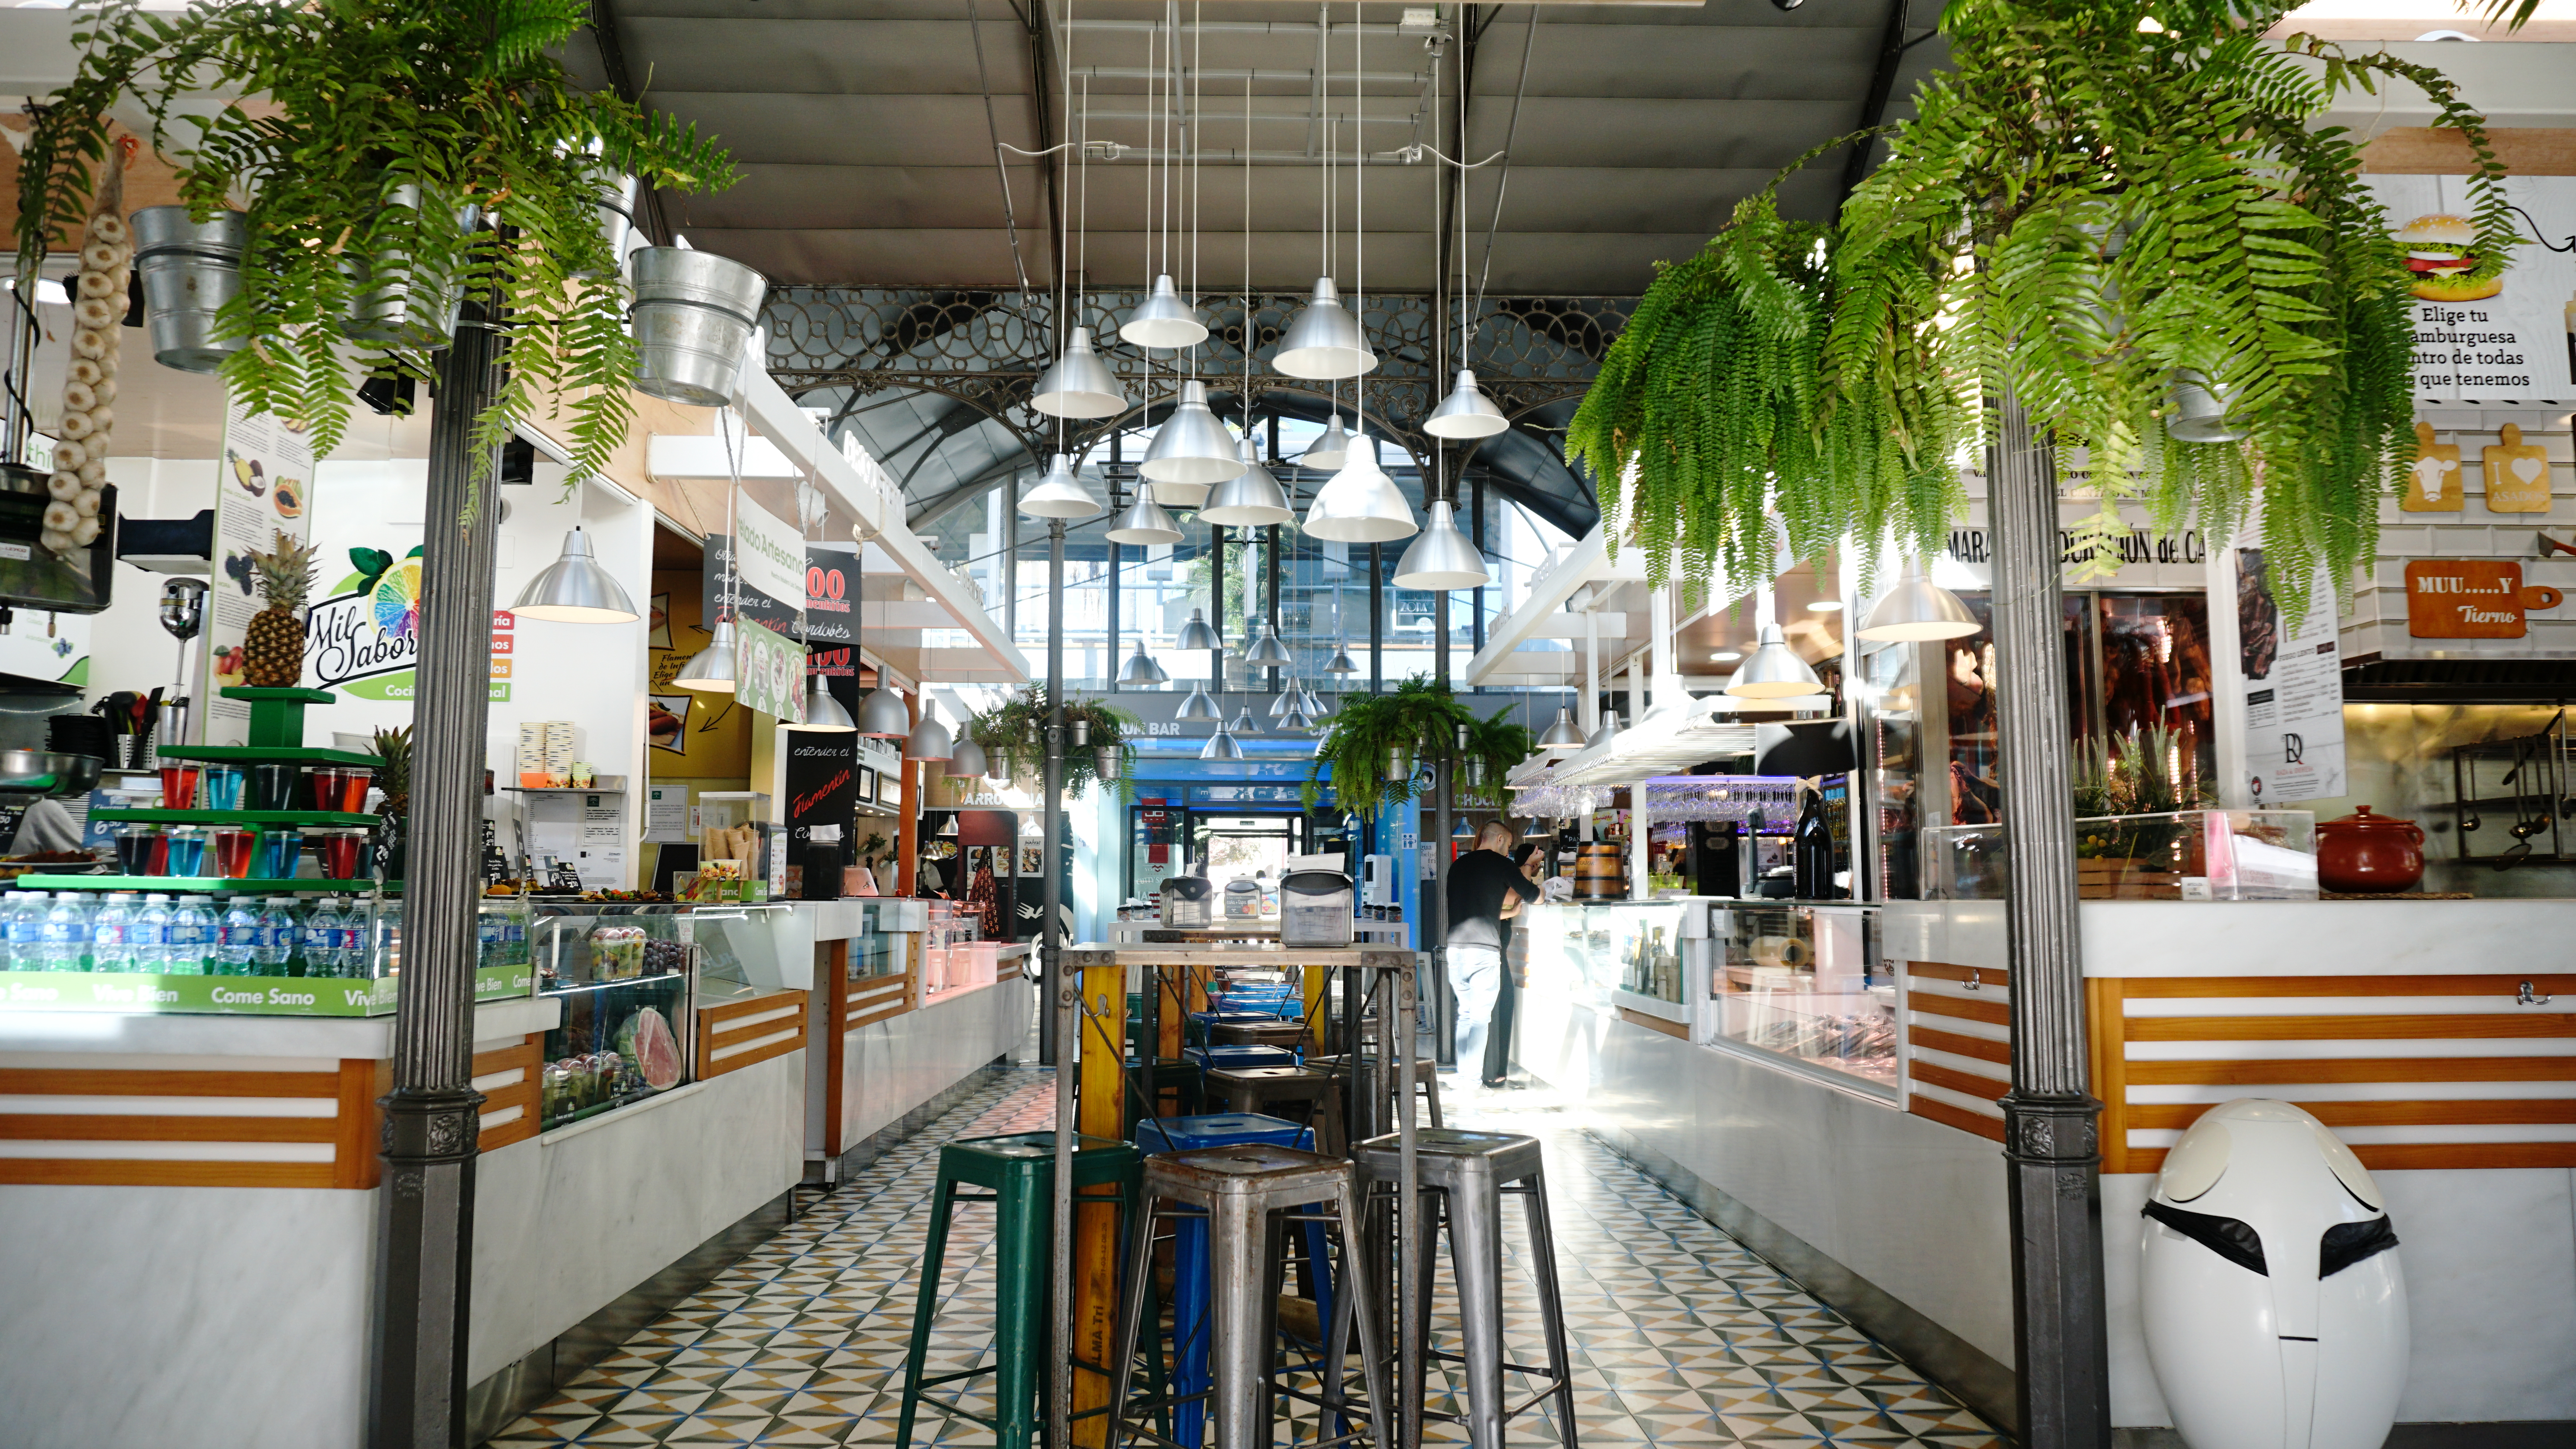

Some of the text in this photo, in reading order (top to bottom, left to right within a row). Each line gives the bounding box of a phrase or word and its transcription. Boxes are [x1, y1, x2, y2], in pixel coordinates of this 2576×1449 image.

[2422, 306, 2489, 326] Elige tu
[2410, 327, 2517, 347] amburguesa
[2452, 349, 2472, 364] de
[2477, 349, 2524, 364] todas
[2420, 375, 2452, 389] que
[2456, 373, 2530, 385] tenemos
[2493, 461, 2502, 485] I
[2492, 491, 2546, 502] ASADOS
[737, 508, 804, 576] Helado Artesano
[2158, 536, 2179, 564] de
[762, 597, 772, 608] el
[2457, 605, 2518, 624] Tierno
[303, 606, 356, 656] Mil
[653, 670, 673, 682] Elige
[1149, 723, 1180, 735] BAR
[794, 746, 850, 757] entender el
[486, 977, 502, 991] Bien
[513, 974, 531, 988] Come
[10, 983, 59, 1001] Sano
[92, 983, 135, 1002] Vive
[137, 985, 179, 1002] Bien
[211, 986, 264, 1004] Come
[268, 987, 316, 1005] Sano
[344, 989, 376, 1006] Vive
[1093, 1305, 1103, 1324] Tri
